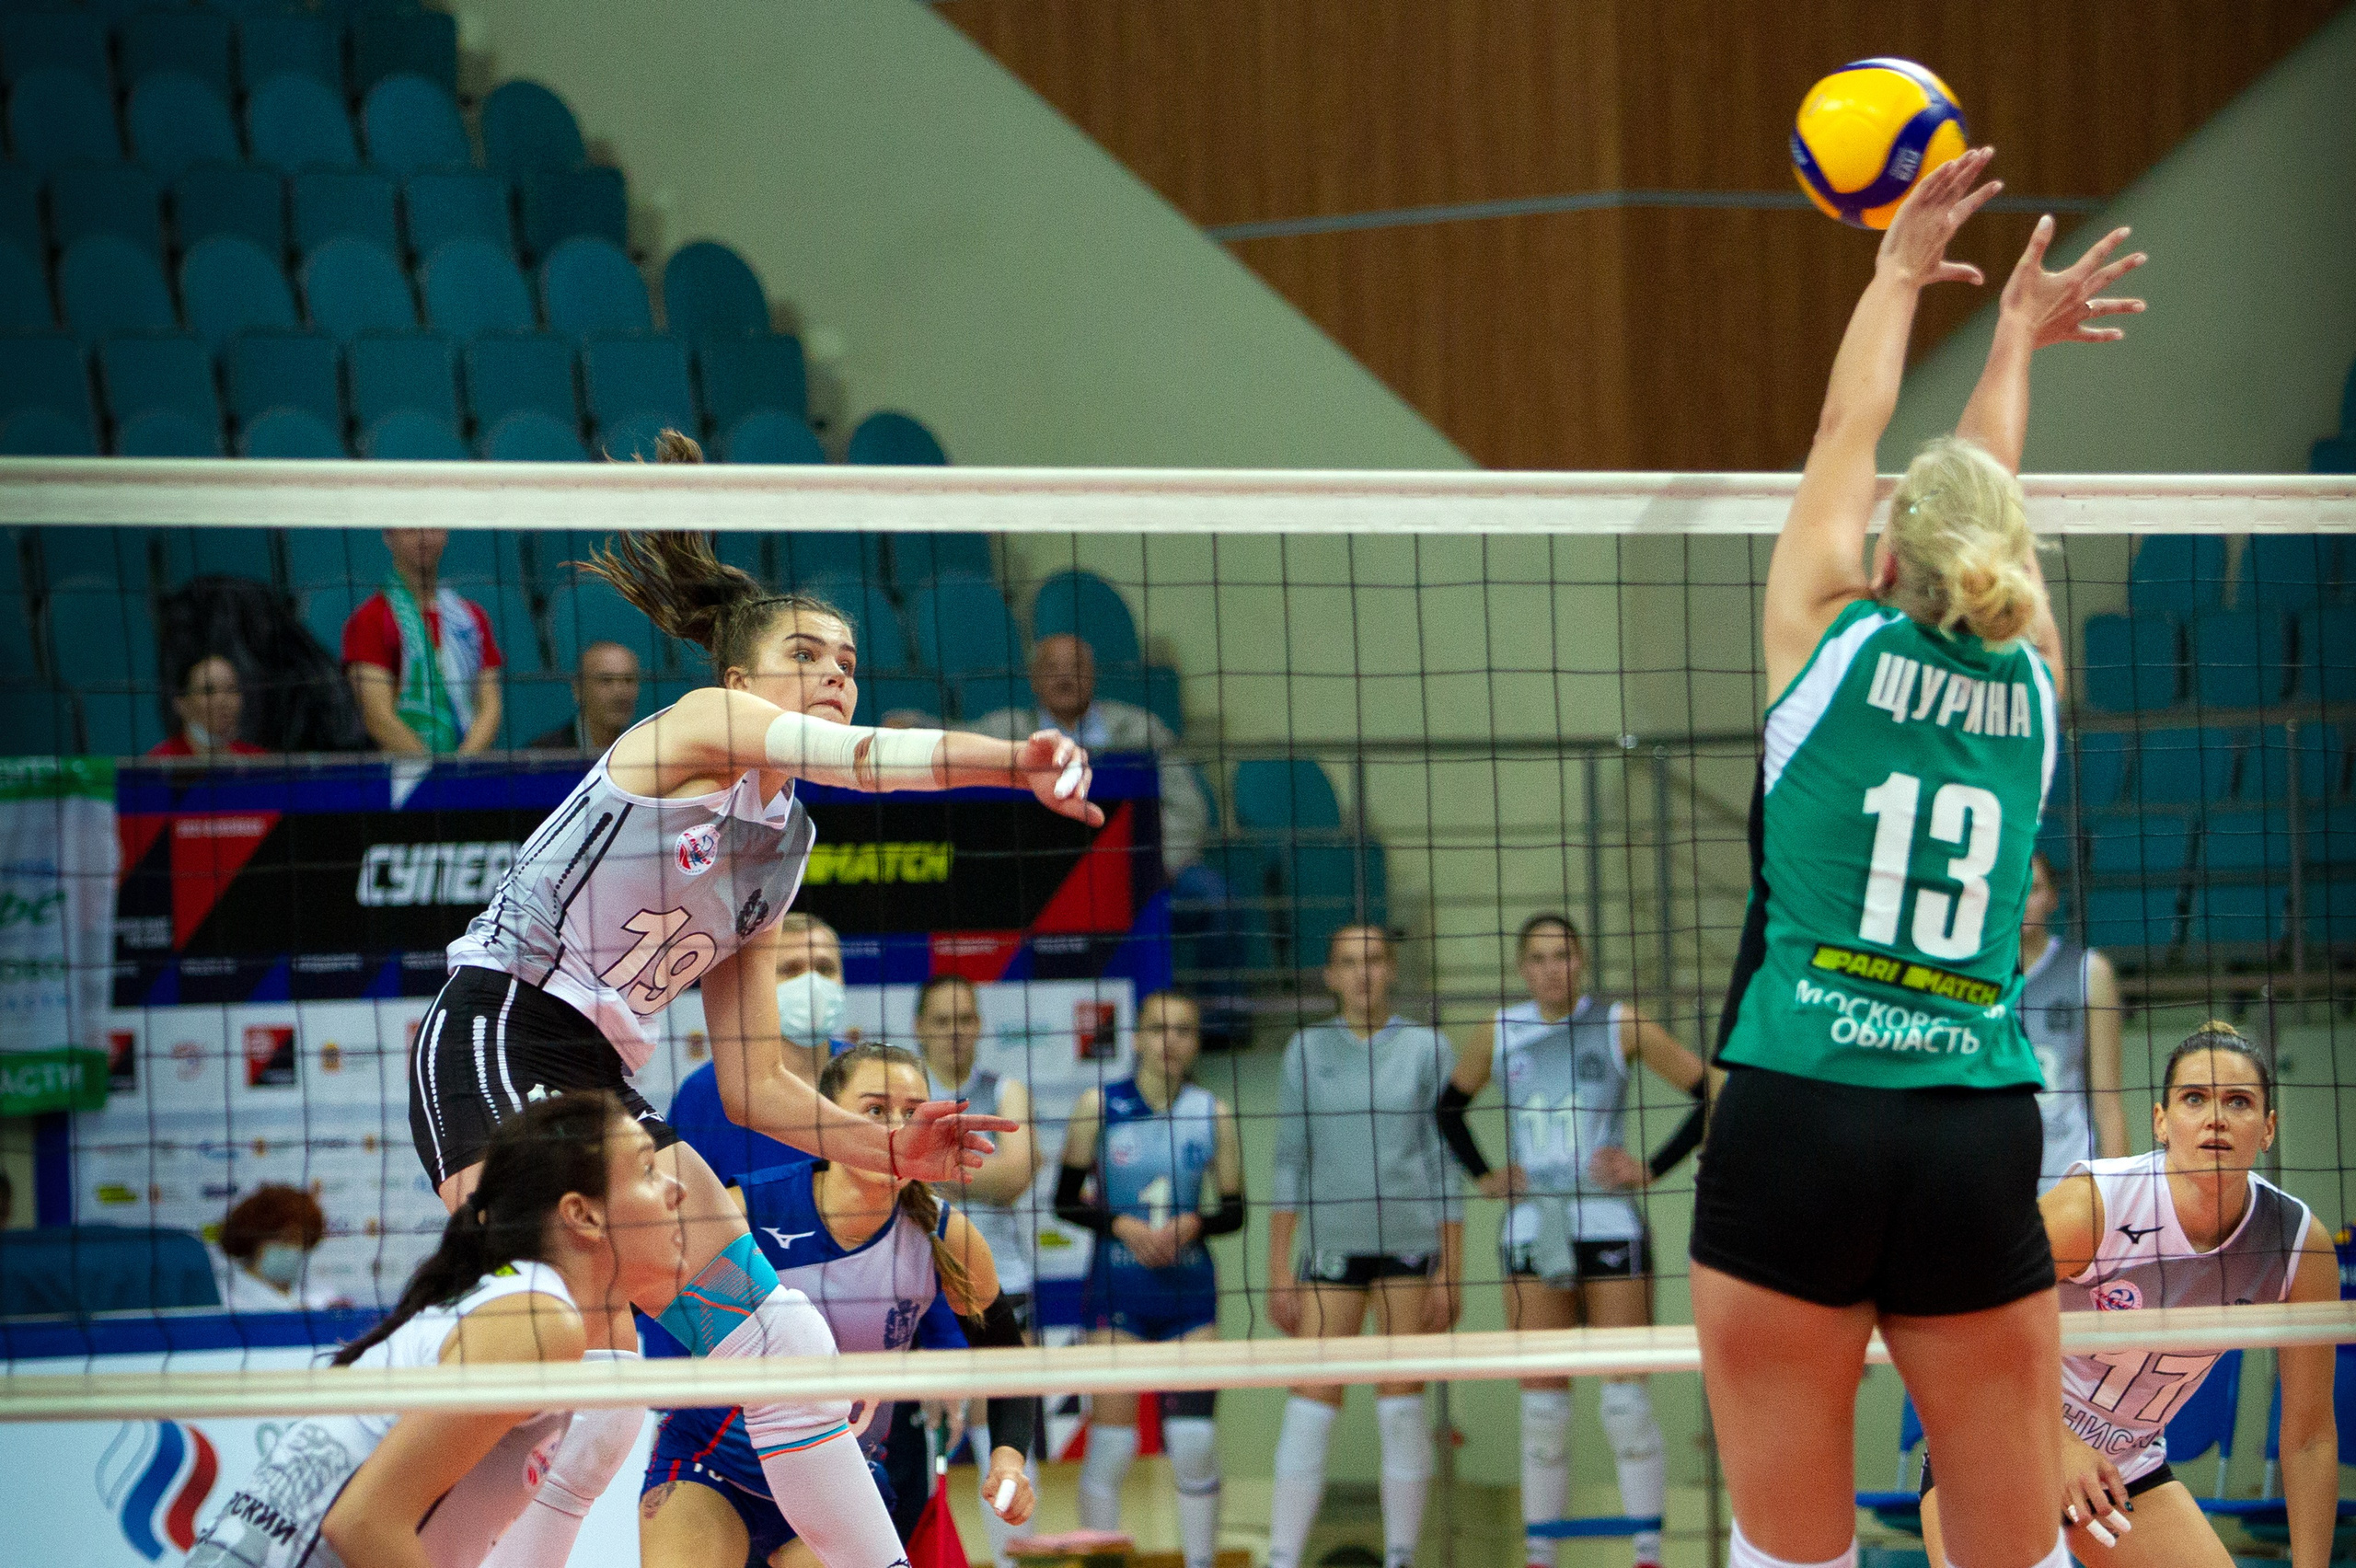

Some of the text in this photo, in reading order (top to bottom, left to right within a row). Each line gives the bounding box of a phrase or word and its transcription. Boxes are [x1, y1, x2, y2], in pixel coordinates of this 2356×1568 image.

[1866, 651, 2031, 737] ЩУРИНА
[1859, 771, 2002, 961] 13
[598, 905, 717, 1016] 19
[1812, 946, 2001, 1007] PARI MATCH
[1831, 1017, 1980, 1055] ОБЛАСТЬ
[2088, 1351, 2221, 1423] 17
